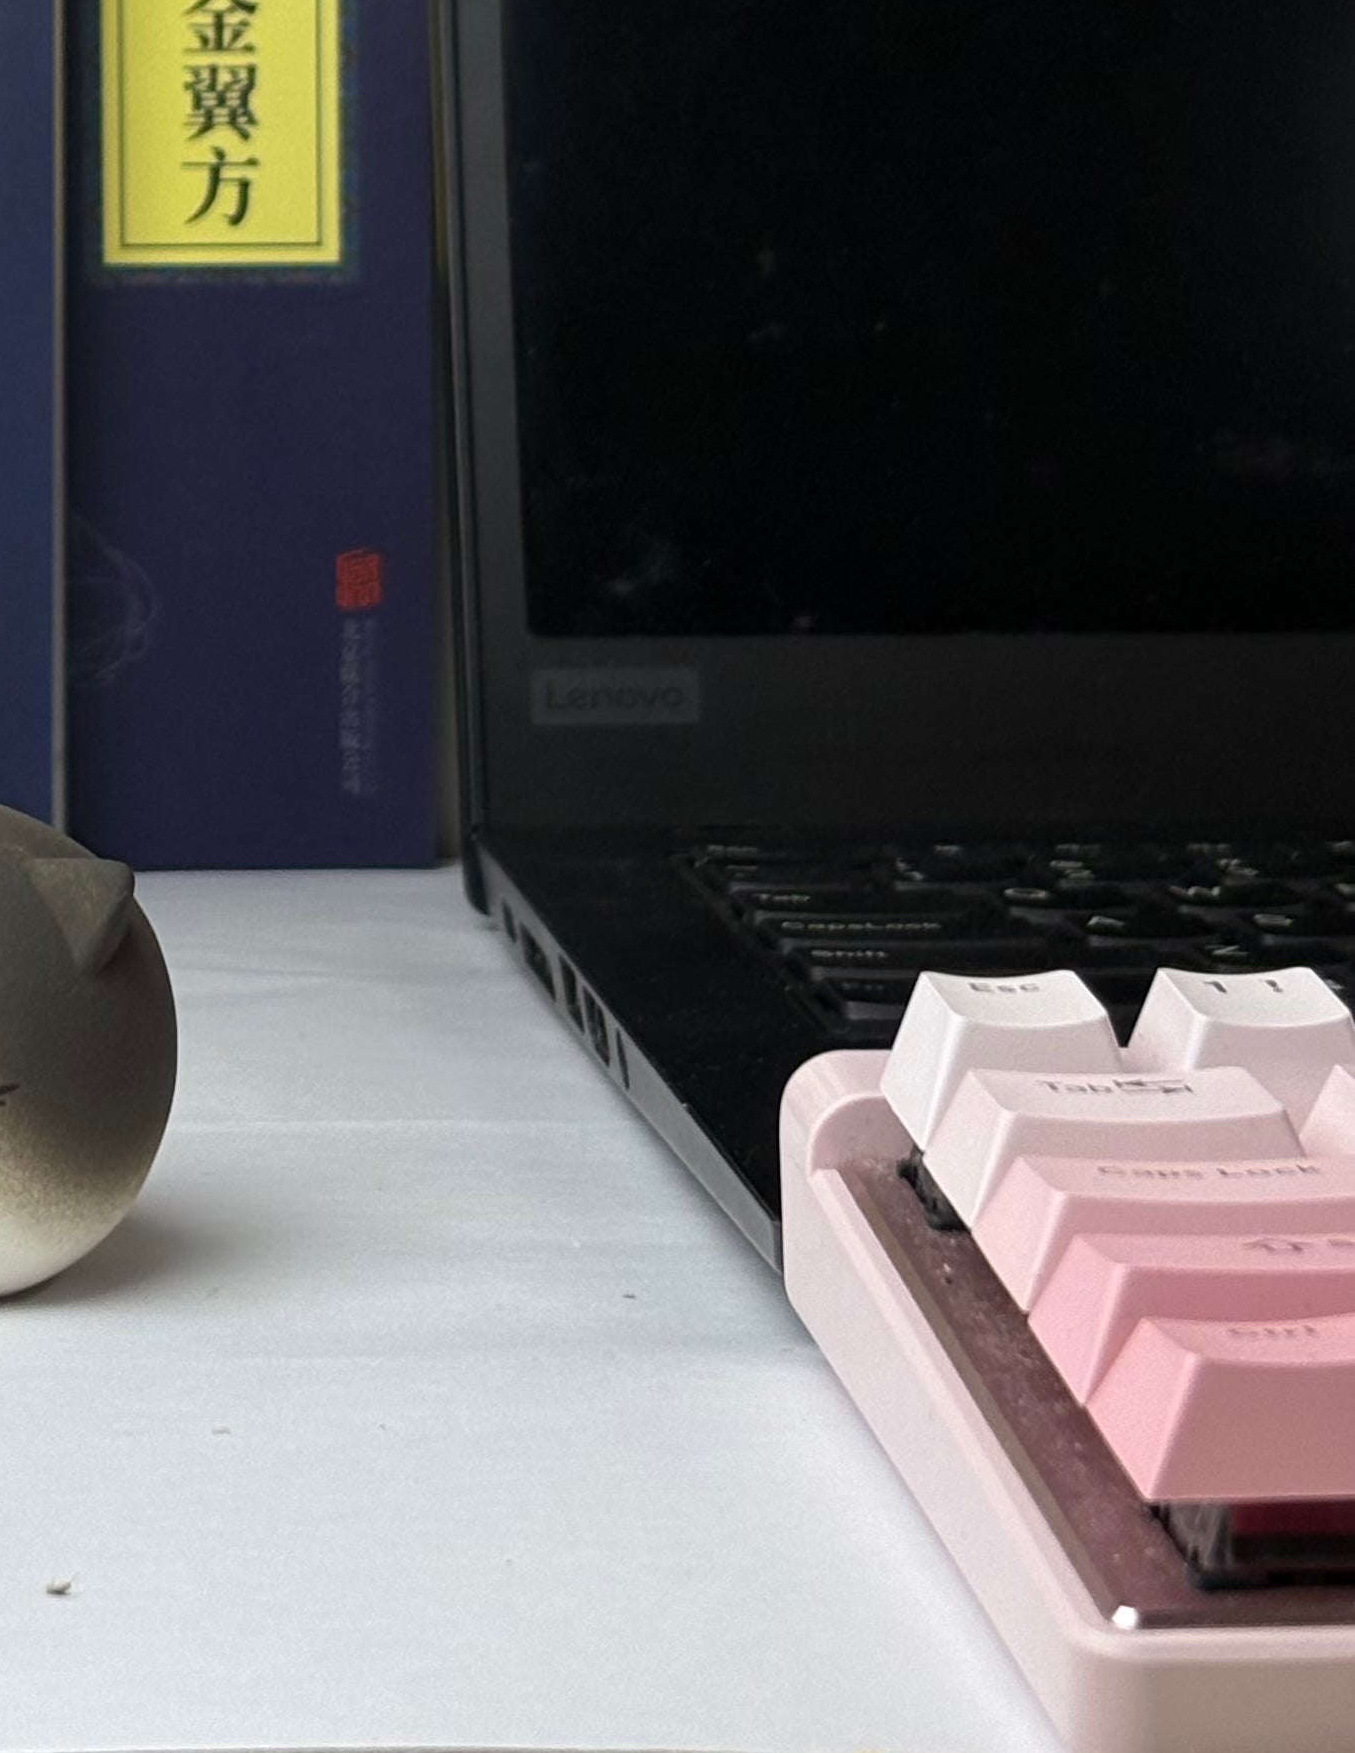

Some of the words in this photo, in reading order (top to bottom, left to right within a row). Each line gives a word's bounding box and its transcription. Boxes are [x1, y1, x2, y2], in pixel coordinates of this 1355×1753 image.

[544, 679, 685, 711] Lenovo
[967, 980, 1041, 995] Esc
[1202, 979, 1228, 995] 1
[1036, 1078, 1113, 1094] Tab
[1097, 1164, 1204, 1180] Caps
[1216, 1162, 1322, 1178] Lock
